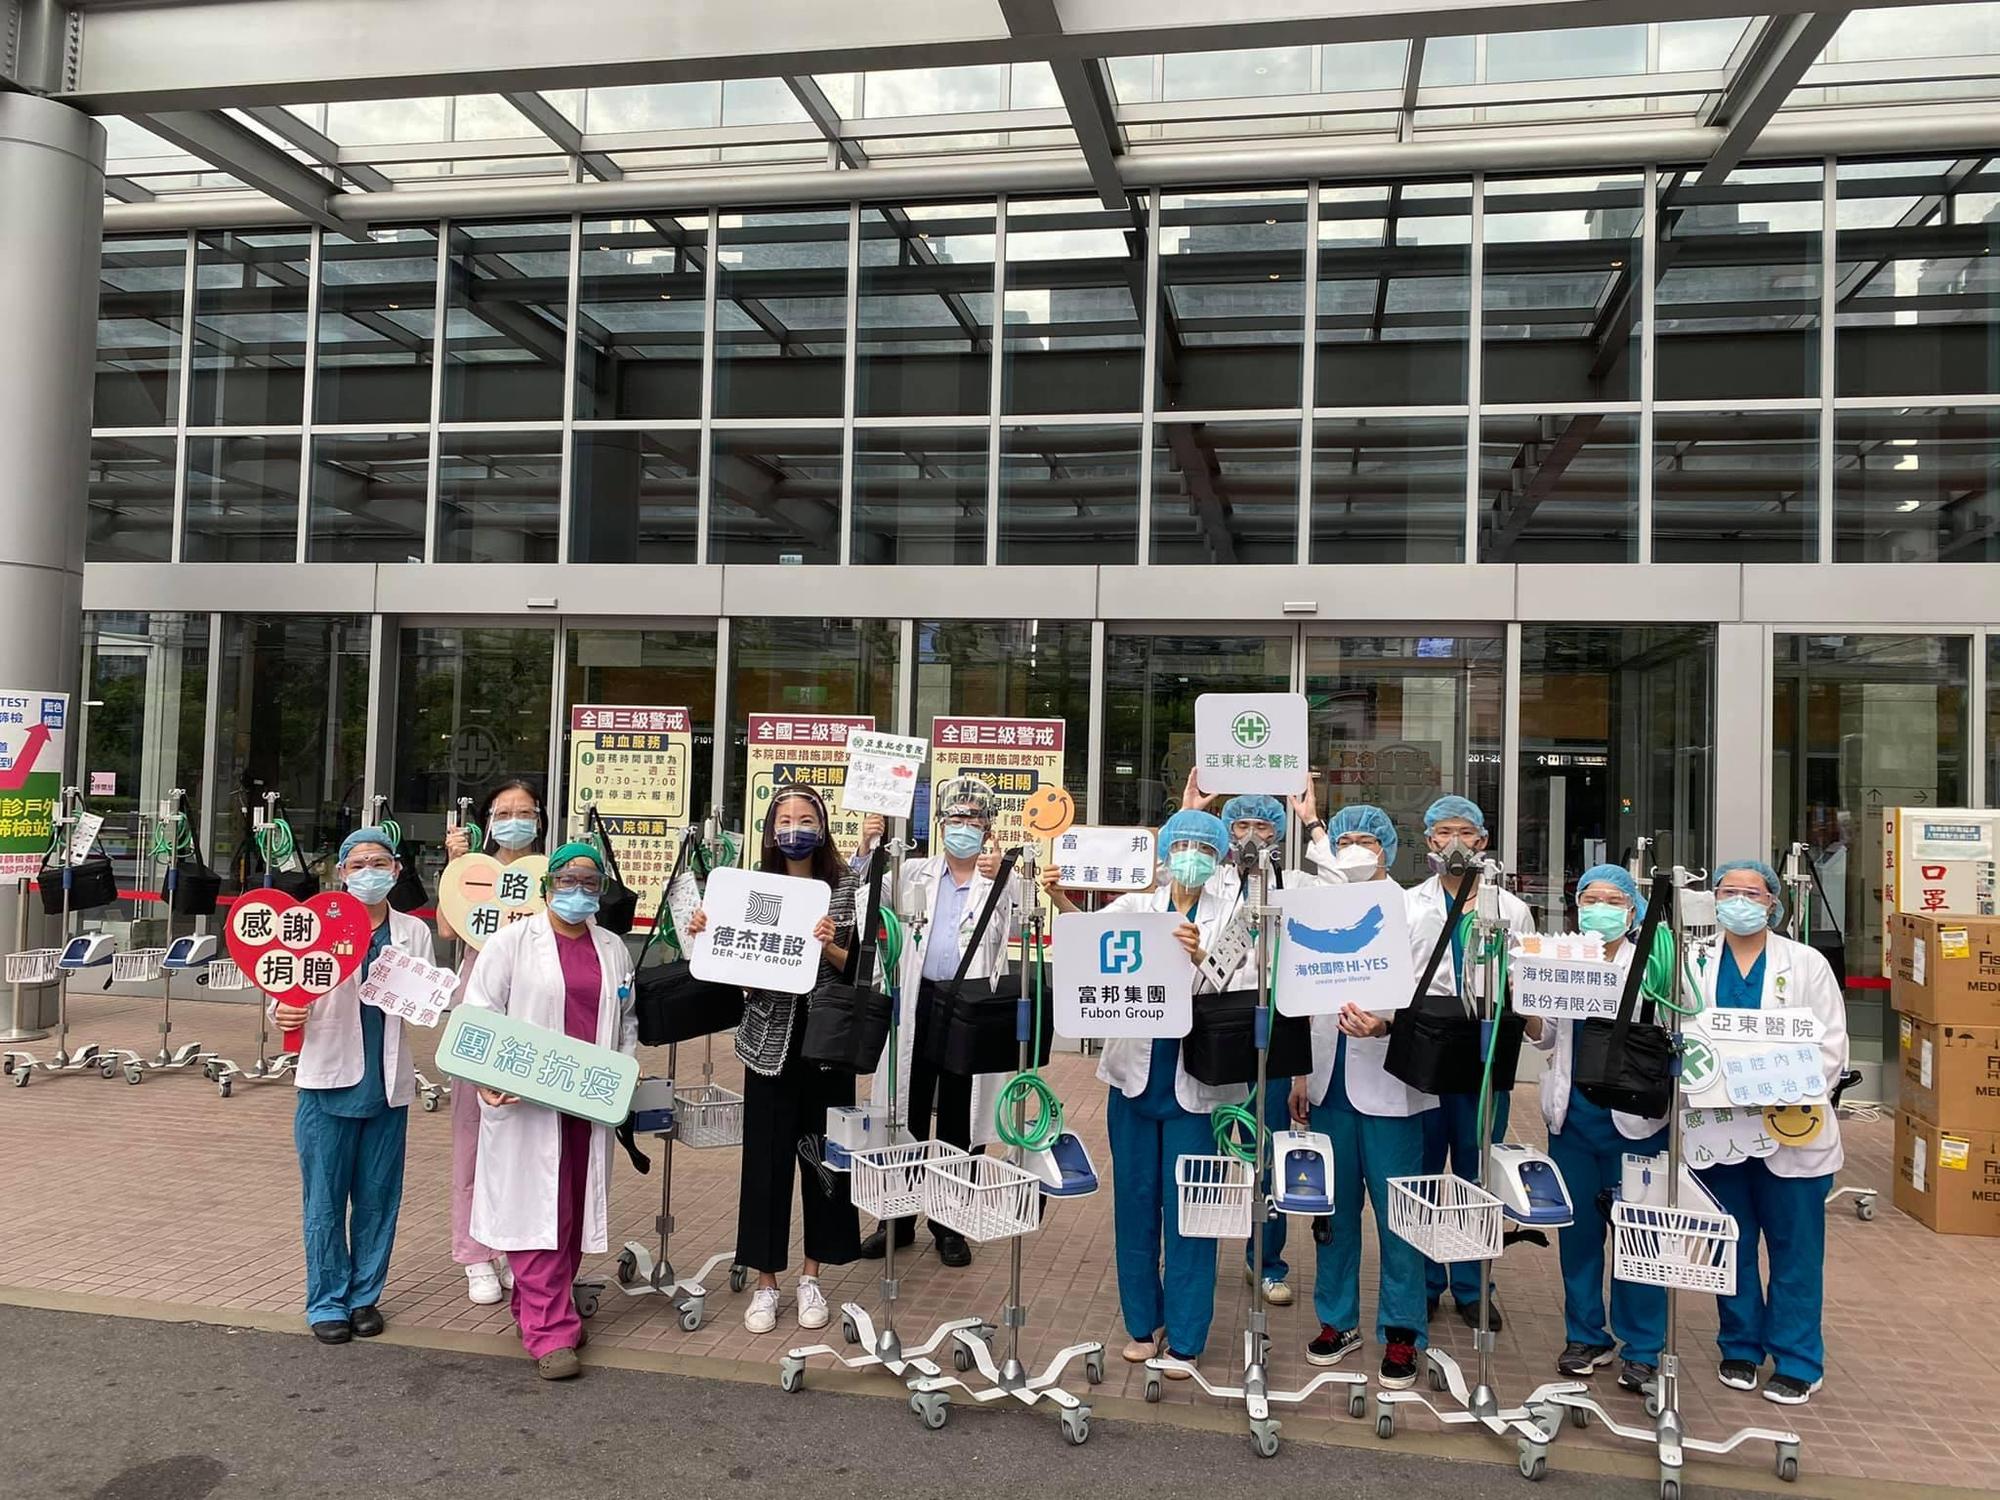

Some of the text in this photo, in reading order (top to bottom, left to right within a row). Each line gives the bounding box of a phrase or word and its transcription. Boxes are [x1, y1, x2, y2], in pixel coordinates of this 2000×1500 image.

[581, 711, 684, 730] 全國三級警戒
[602, 734, 661, 749] 抽血服務
[942, 725, 1054, 746] 全國三級警戒
[936, 752, 1057, 766] 本院因應措施調整如下
[1205, 754, 1299, 769] 亞東紀念醫院
[779, 767, 844, 784] 入院相關
[626, 875, 669, 886] 南棟大
[1060, 865, 1147, 884] 蔡董事長
[1920, 865, 1950, 912] 口罩
[241, 908, 314, 943] 感謝
[712, 925, 806, 958] 德杰建設
[711, 948, 803, 967] DER-JEY GROUP
[1294, 957, 1389, 976] 海悅國際 HI-YES
[263, 955, 333, 987] 捐贈
[1522, 966, 1618, 987] 海悅國際開發
[360, 983, 437, 1025] 氧氣治療
[1078, 985, 1166, 1004] 富邦集團
[1522, 993, 1617, 1014] 股份有限公司
[1081, 1007, 1164, 1021] Fubon Group
[1711, 1013, 1813, 1038] 亞東醫院
[452, 1022, 623, 1106] 團結抗疫
[1727, 1048, 1812, 1074] 胸腔內科
[1734, 1075, 1822, 1099] 呼吸治療
[1696, 1133, 1773, 1162] 心人士
